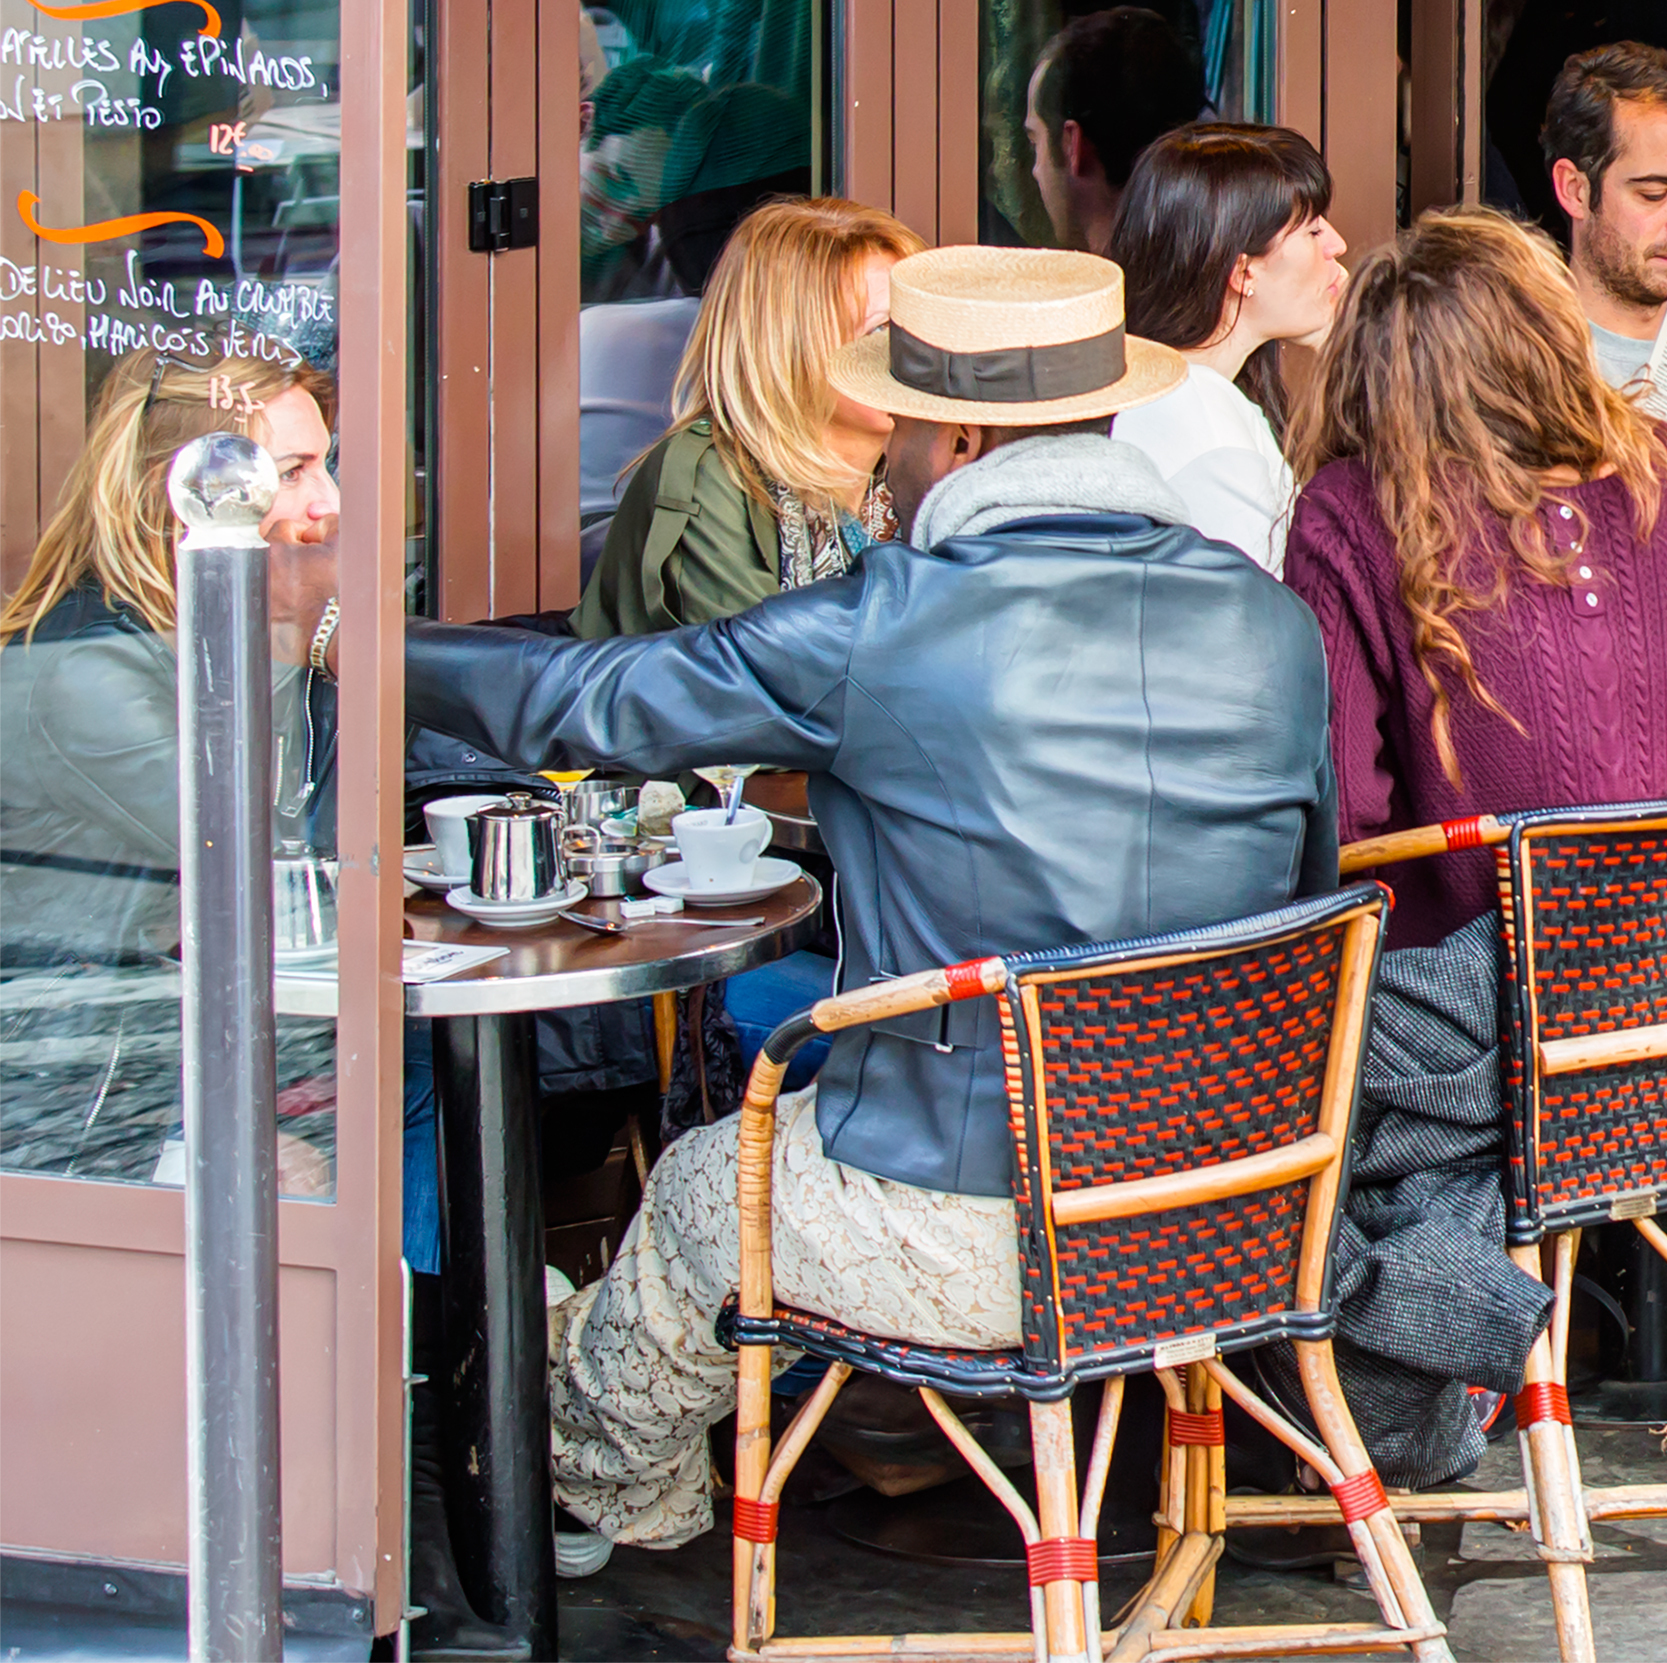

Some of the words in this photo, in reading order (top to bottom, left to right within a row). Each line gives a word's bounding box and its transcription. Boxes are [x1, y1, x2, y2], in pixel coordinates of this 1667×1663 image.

[32, 88, 63, 123] ET
[70, 79, 162, 130] PESTO
[43, 265, 106, 305] LIEU
[118, 249, 191, 318] NOIR
[197, 279, 230, 315] AU
